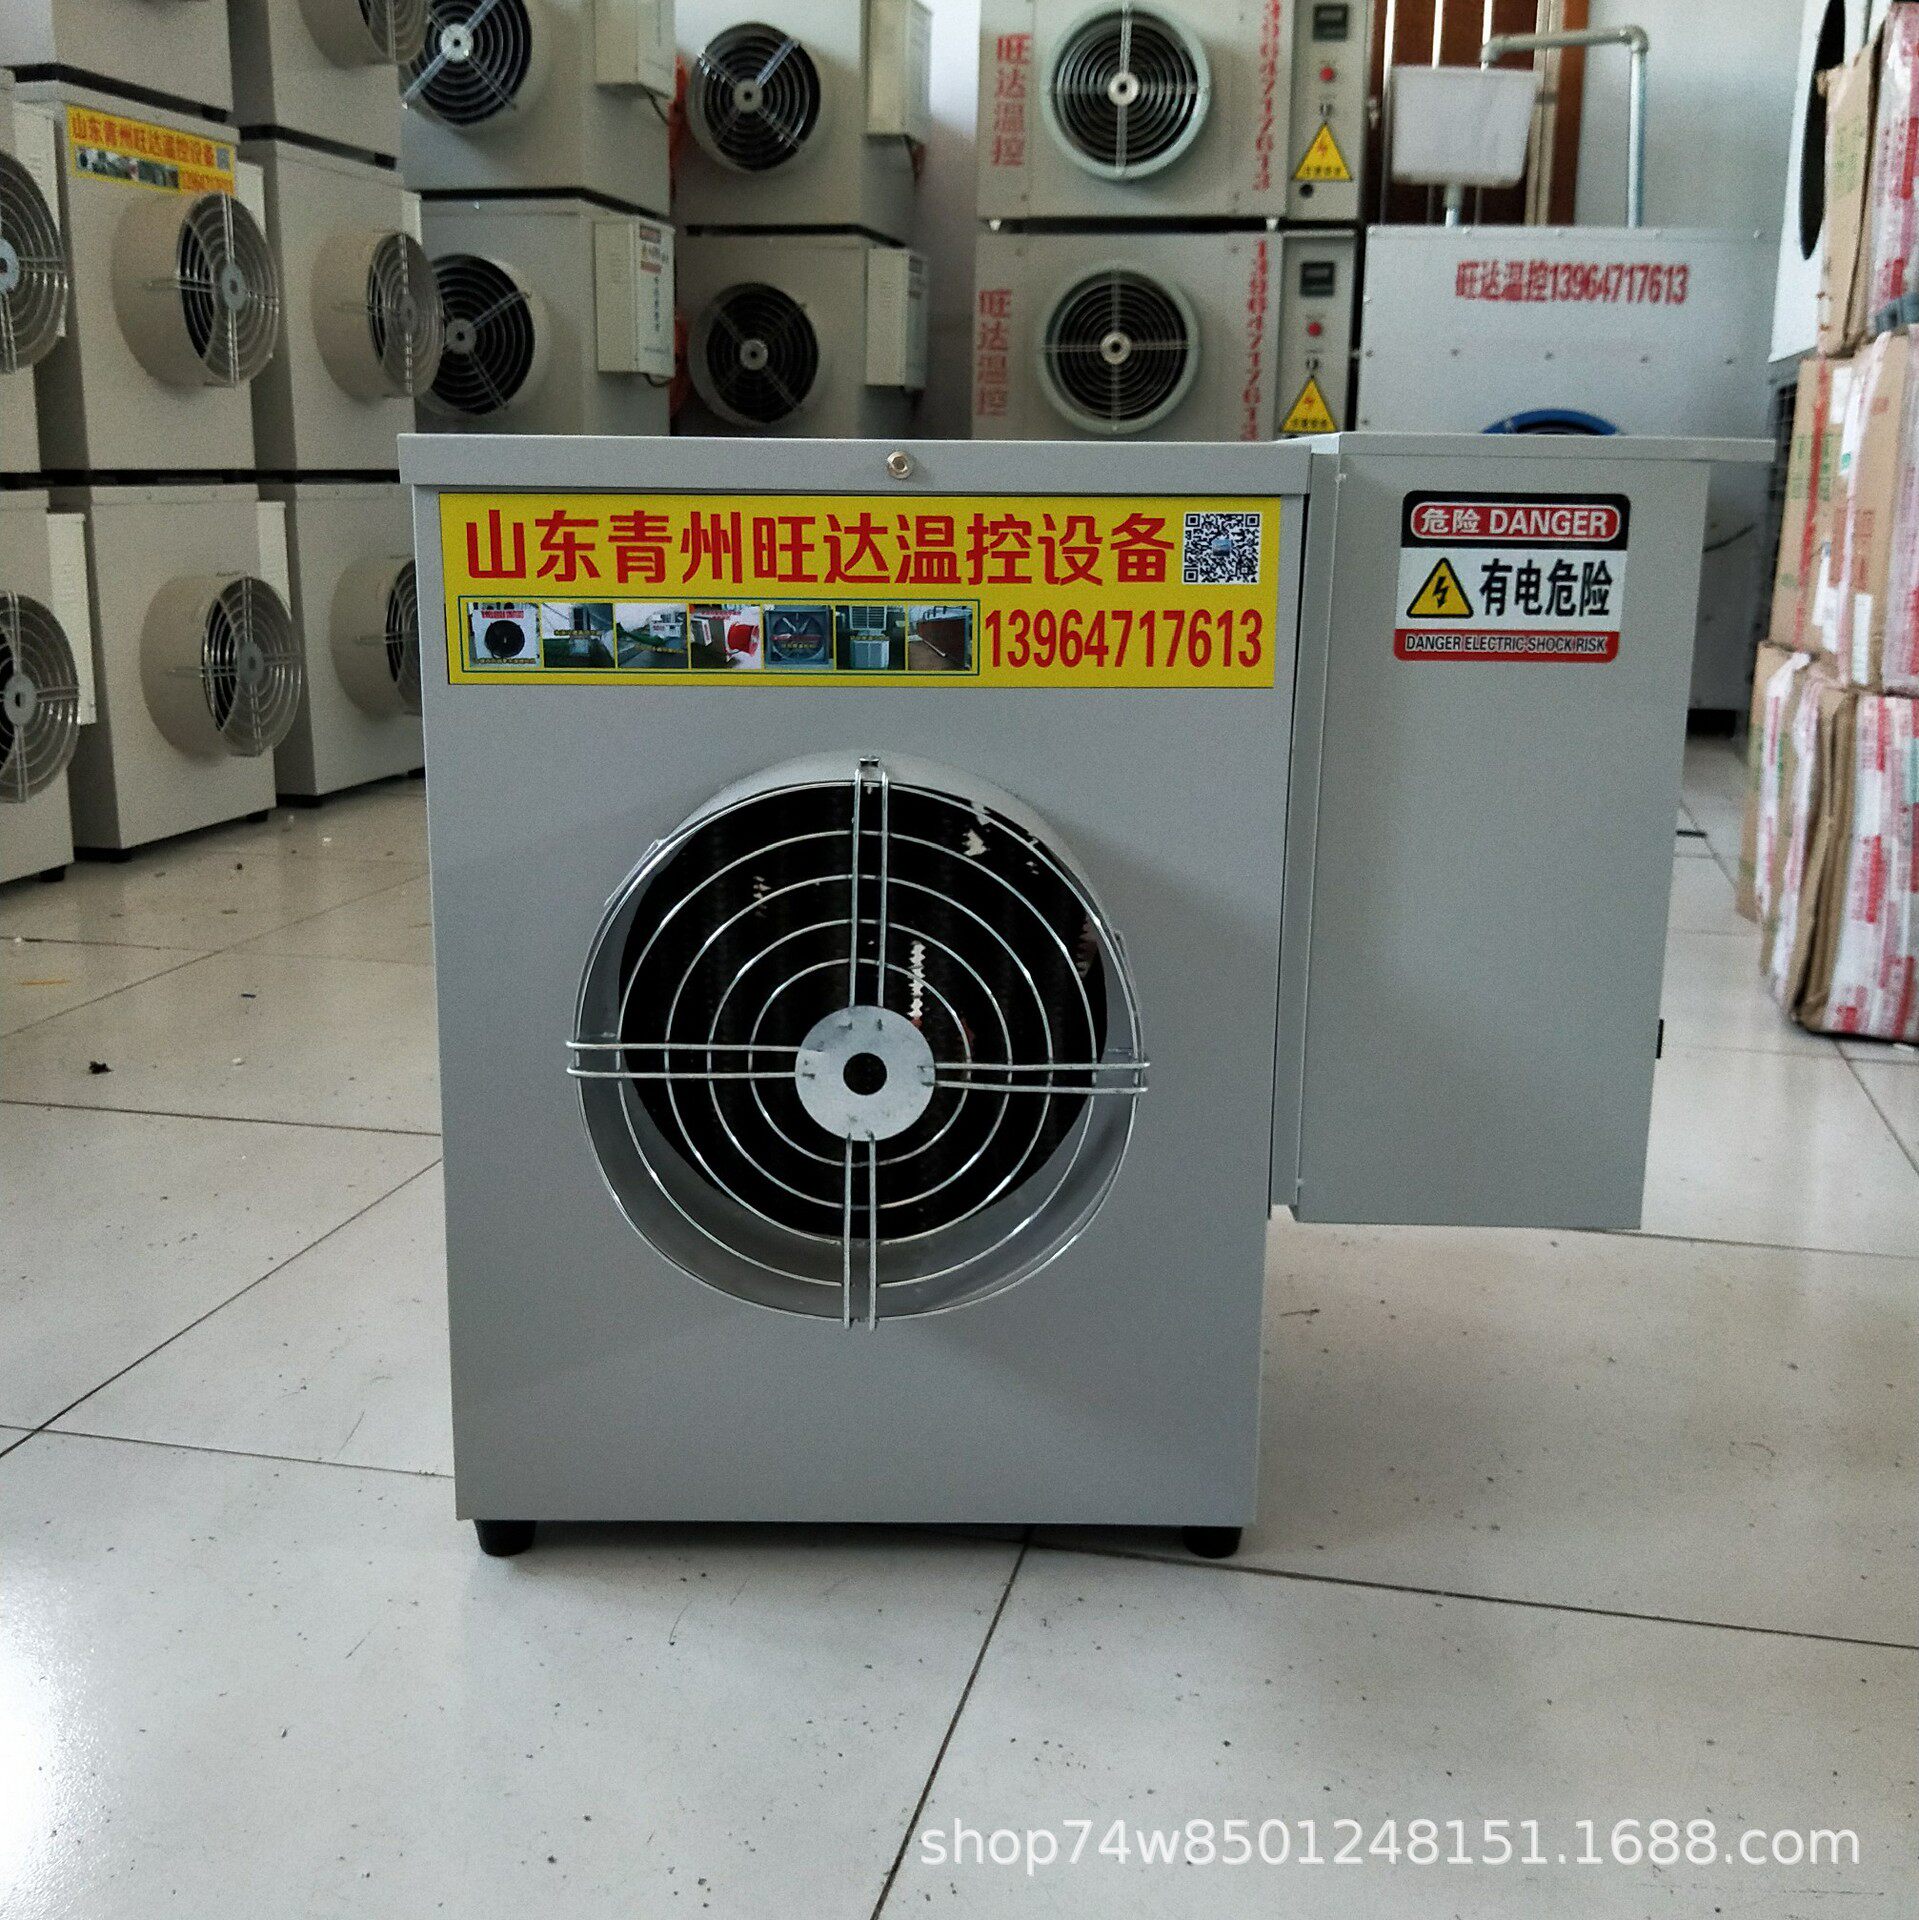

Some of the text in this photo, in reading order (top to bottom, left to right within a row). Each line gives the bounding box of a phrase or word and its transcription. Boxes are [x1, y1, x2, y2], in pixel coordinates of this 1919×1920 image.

[993, 32, 1032, 166] 旺达温控
[465, 509, 1175, 586] 山东青州旺达温控设备
[1420, 508, 1609, 537] 危险 DANGER
[1479, 558, 1613, 617] 有电危险
[984, 608, 1263, 669] 13964717613
[1406, 635, 1606, 652] DANGER ELECTRIC SHOCK RISK
